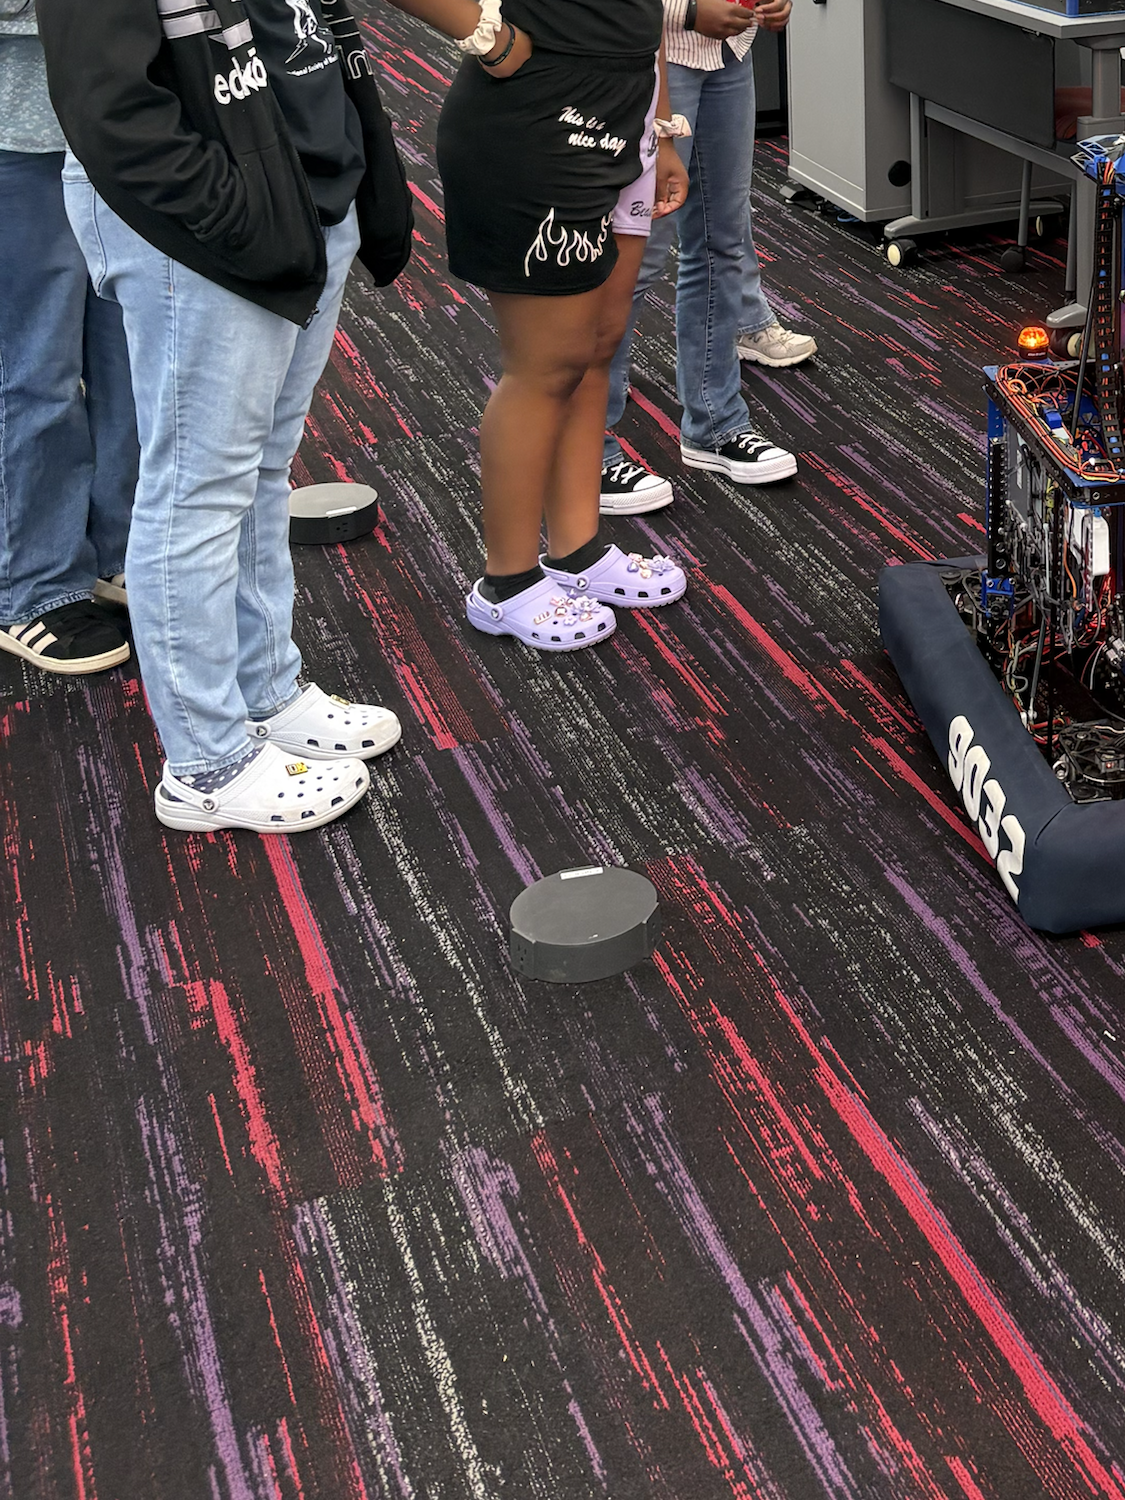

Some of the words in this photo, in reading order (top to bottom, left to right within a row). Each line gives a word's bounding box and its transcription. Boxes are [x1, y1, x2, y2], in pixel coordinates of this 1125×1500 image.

[558, 106, 585, 127] This
[568, 131, 598, 148] nice
[600, 132, 628, 157] day
[948, 715, 1026, 905] 9032
